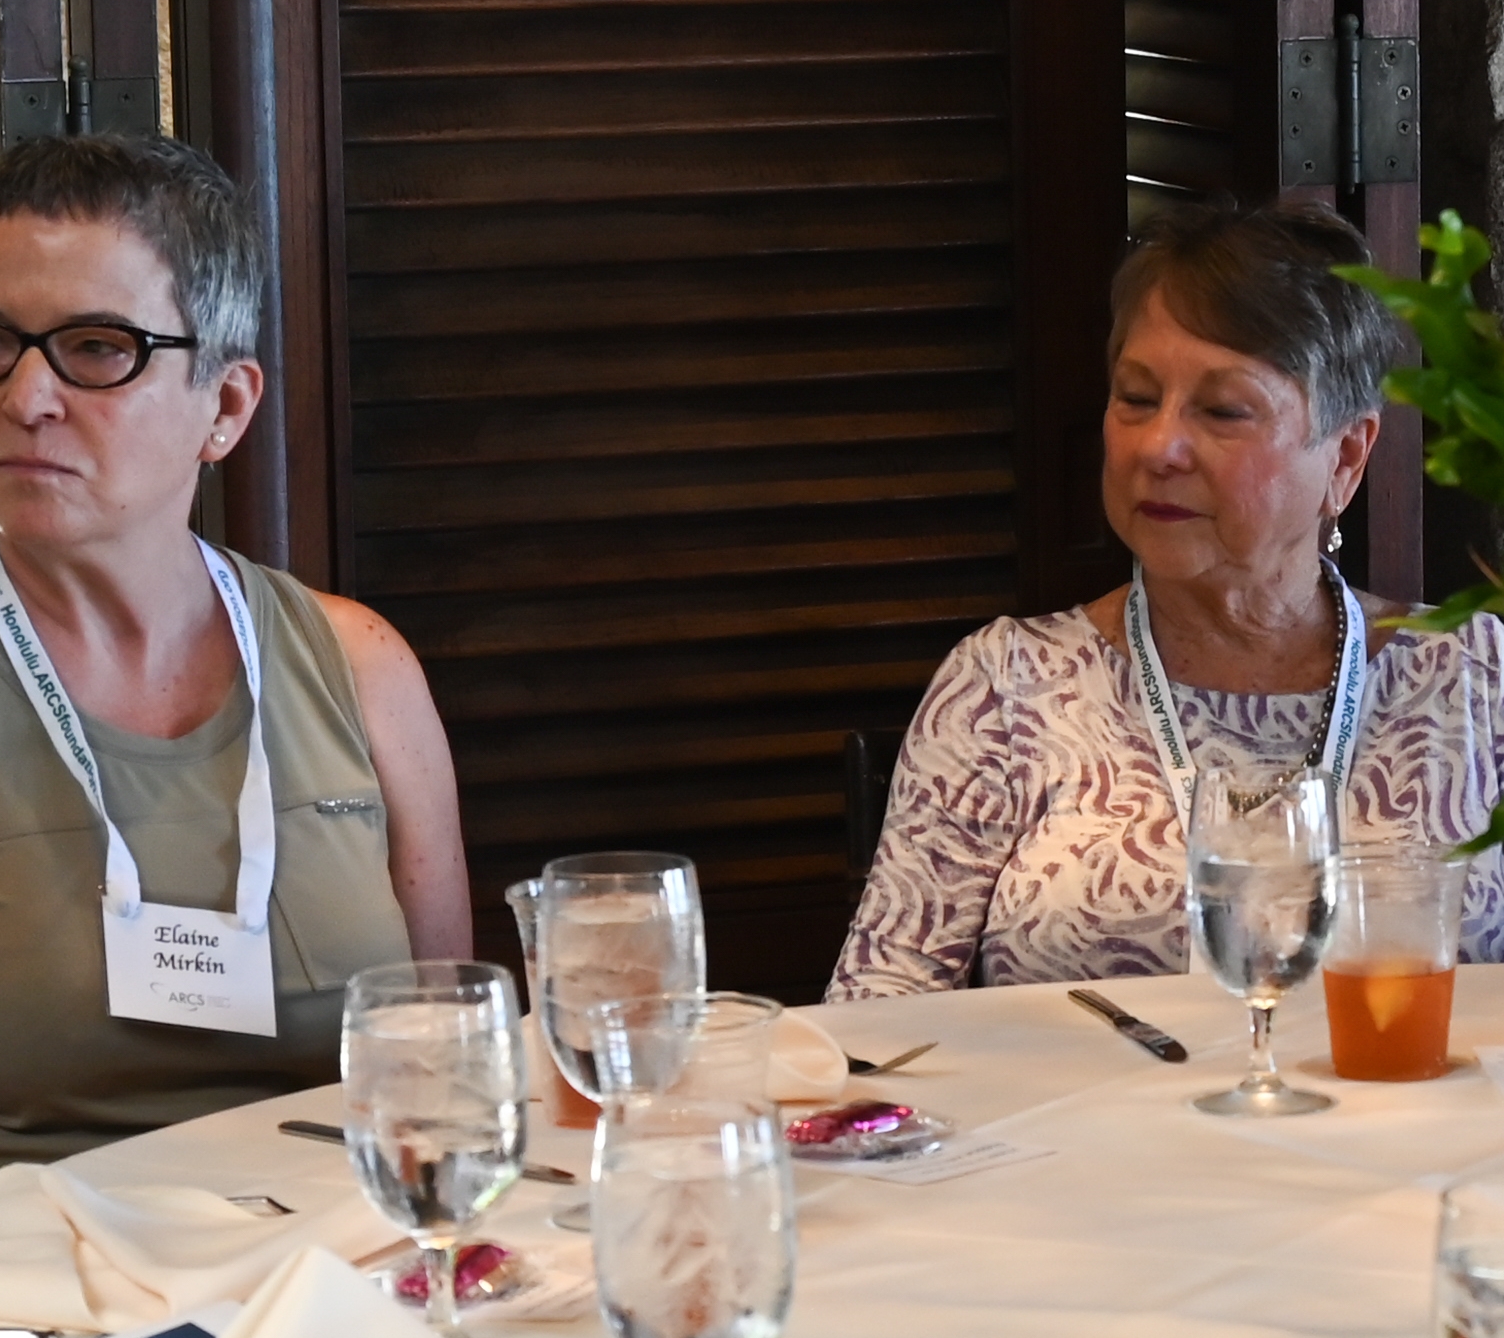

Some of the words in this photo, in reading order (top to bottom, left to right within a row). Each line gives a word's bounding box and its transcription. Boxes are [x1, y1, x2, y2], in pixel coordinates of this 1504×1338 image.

[154, 924, 220, 948] Elaine
[153, 952, 226, 975] Mirkin
[168, 991, 205, 1006] ARCS
